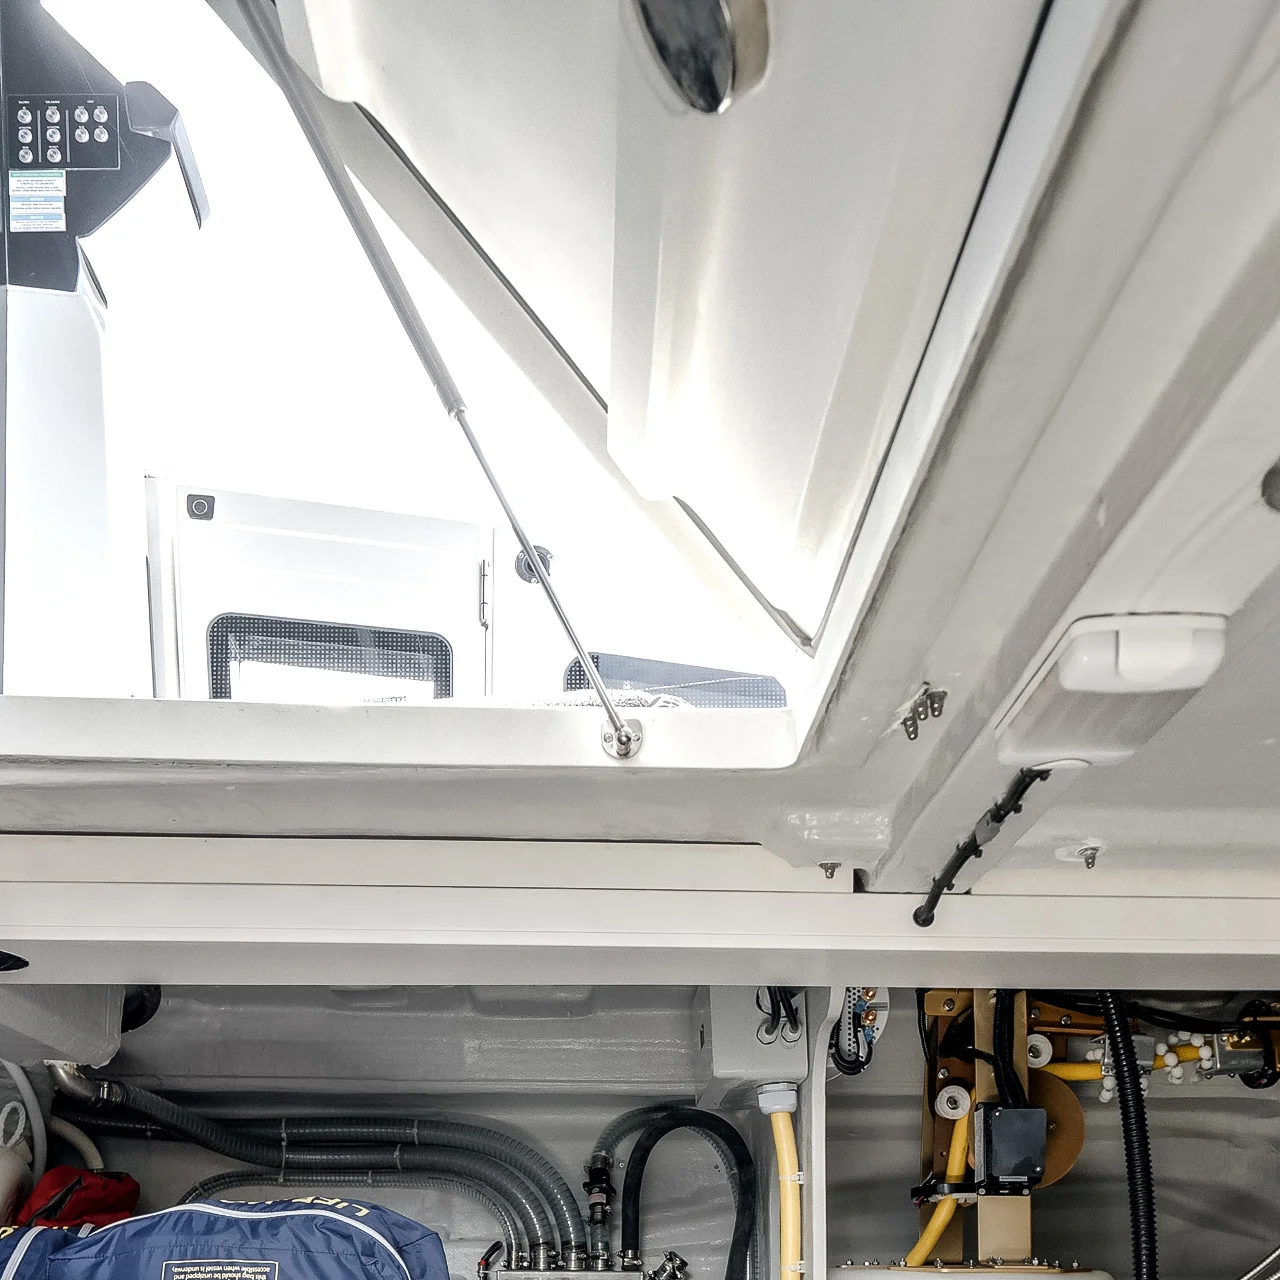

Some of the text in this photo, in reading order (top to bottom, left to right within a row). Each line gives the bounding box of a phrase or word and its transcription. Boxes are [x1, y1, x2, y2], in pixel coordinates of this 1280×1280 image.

[205, 1265, 223, 1273] vessel
[223, 1265, 241, 1273] when
[185, 1272, 213, 1280] unzipped
[221, 1272, 242, 1280] should
